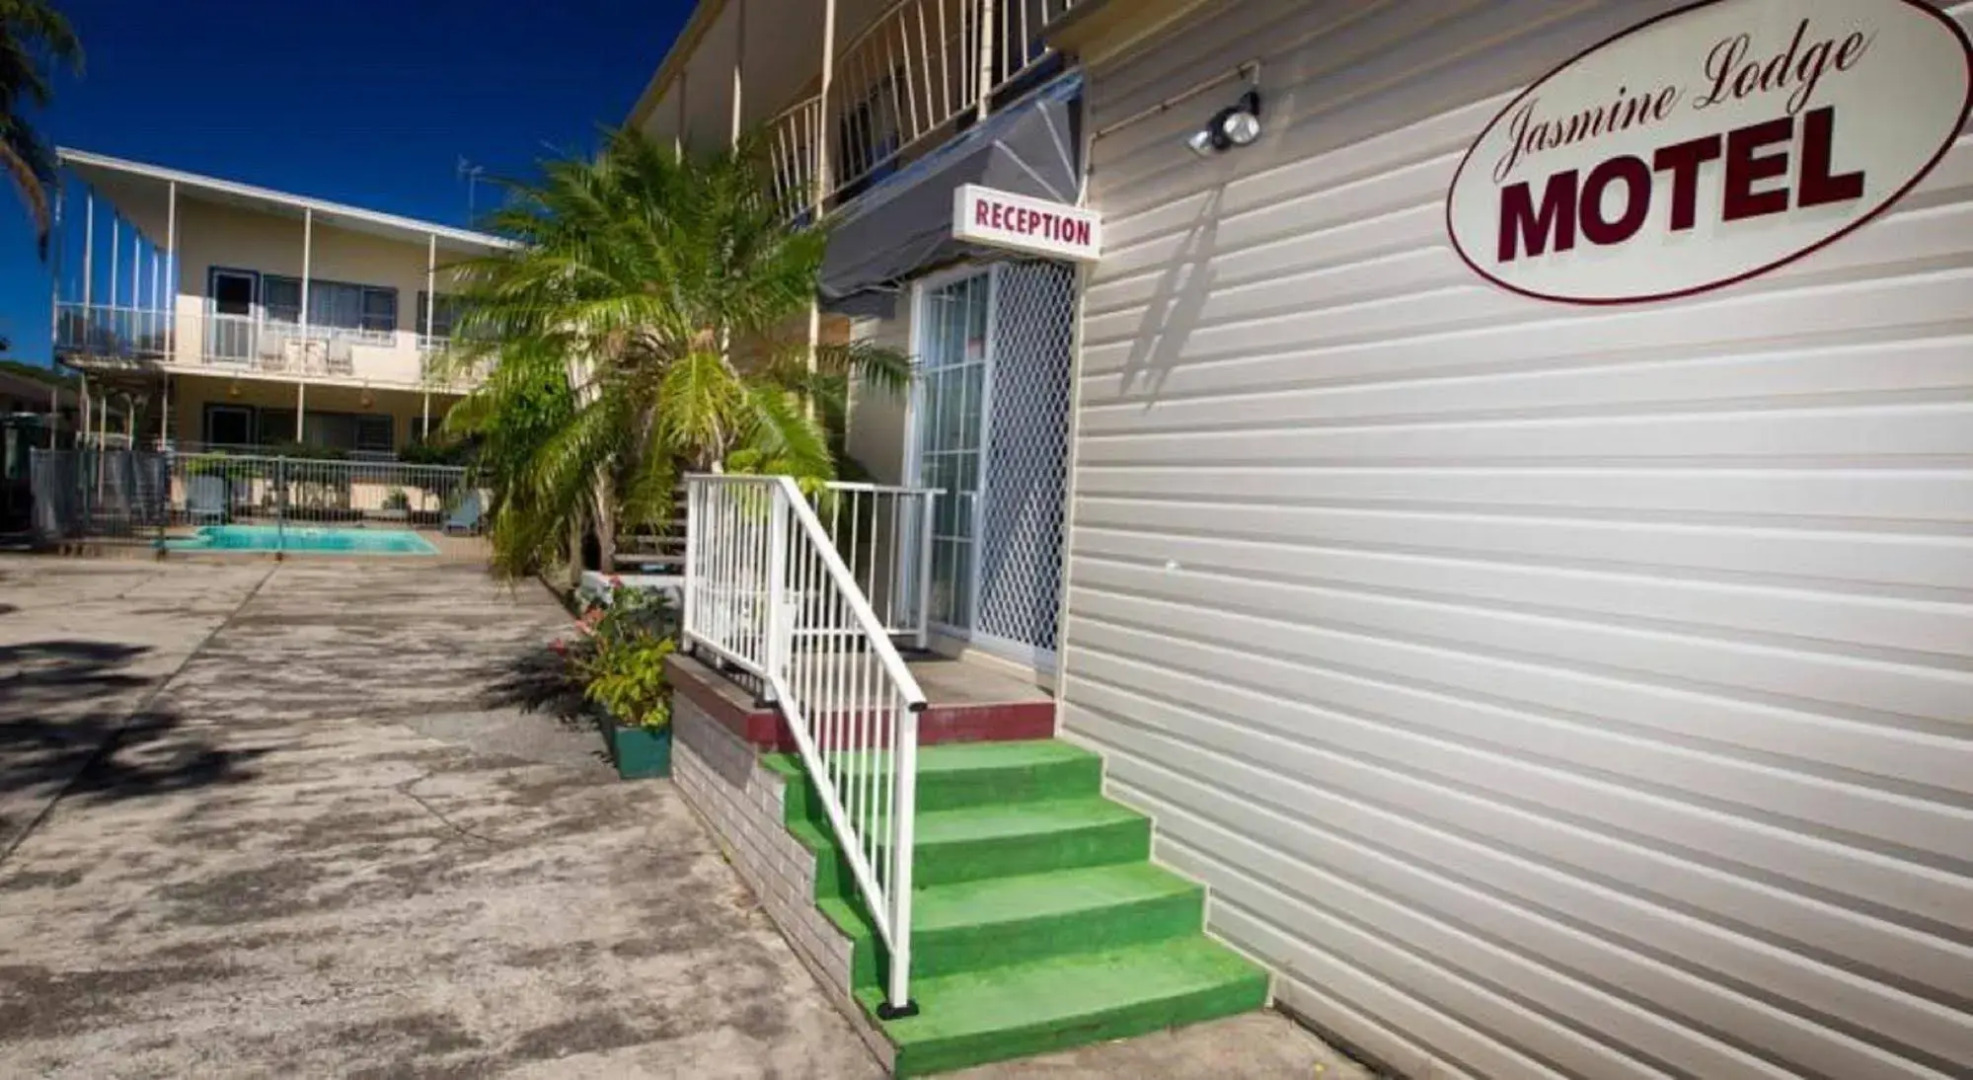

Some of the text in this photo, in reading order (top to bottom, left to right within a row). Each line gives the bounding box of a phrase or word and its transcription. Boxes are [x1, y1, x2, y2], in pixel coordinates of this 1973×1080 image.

[1493, 18, 1875, 183] Jasmine Lodge
[975, 198, 1091, 246] RECEPTION
[1497, 105, 1866, 263] MOTEL
